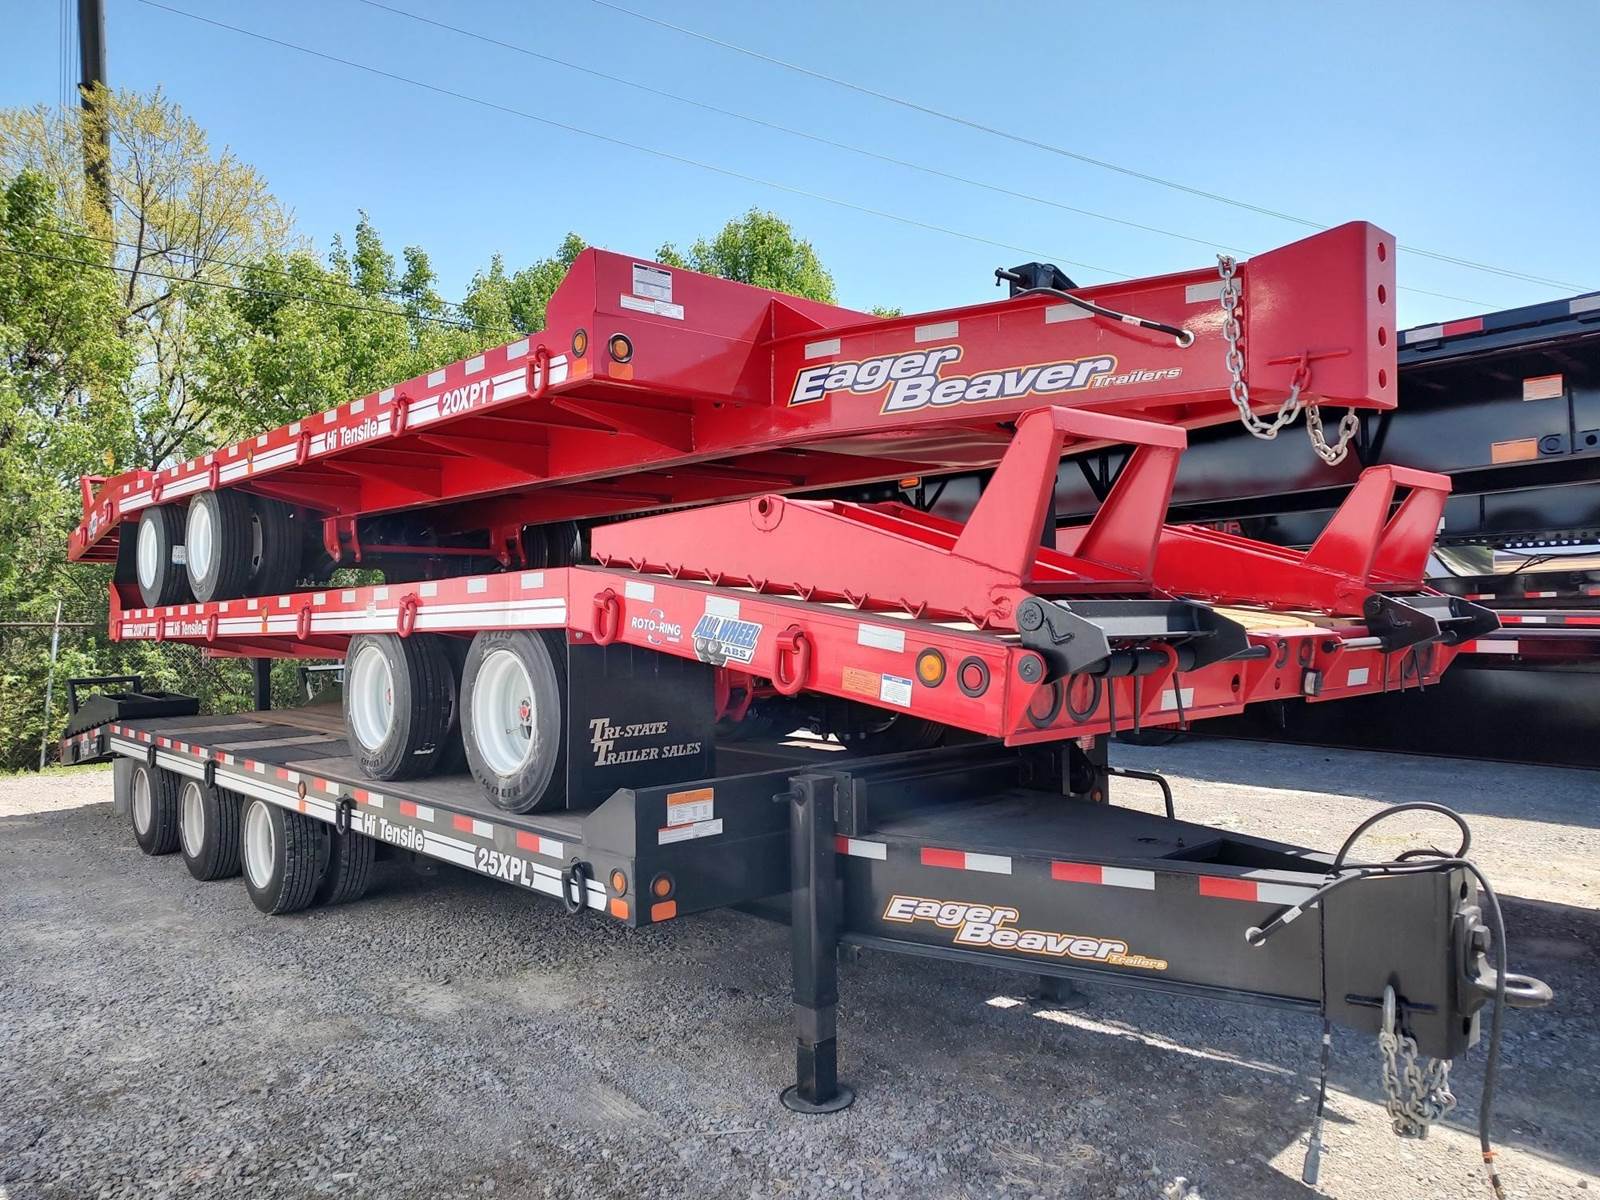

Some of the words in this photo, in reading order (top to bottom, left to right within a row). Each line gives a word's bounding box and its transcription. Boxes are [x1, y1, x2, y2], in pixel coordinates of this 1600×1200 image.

[790, 346, 961, 405] Eager
[883, 356, 1115, 412] Beaver
[1093, 366, 1182, 389] Trailers
[442, 380, 491, 416] 20XPT
[326, 430, 337, 450] Hi
[340, 417, 378, 446] Tensile
[631, 616, 681, 636] ROTO-RING
[694, 614, 720, 640] ALL
[717, 619, 761, 648] WHEEL
[724, 646, 746, 658] ABS
[589, 718, 668, 743] TRI-STATE
[593, 740, 659, 767] TRAILER
[661, 742, 701, 759] SALES
[362, 814, 376, 835] Hi
[379, 818, 424, 852] Tensile
[478, 847, 532, 887] 25XPL
[883, 895, 1019, 927] Eager
[953, 920, 1128, 961] Beaver
[1108, 953, 1168, 970] Trailers
